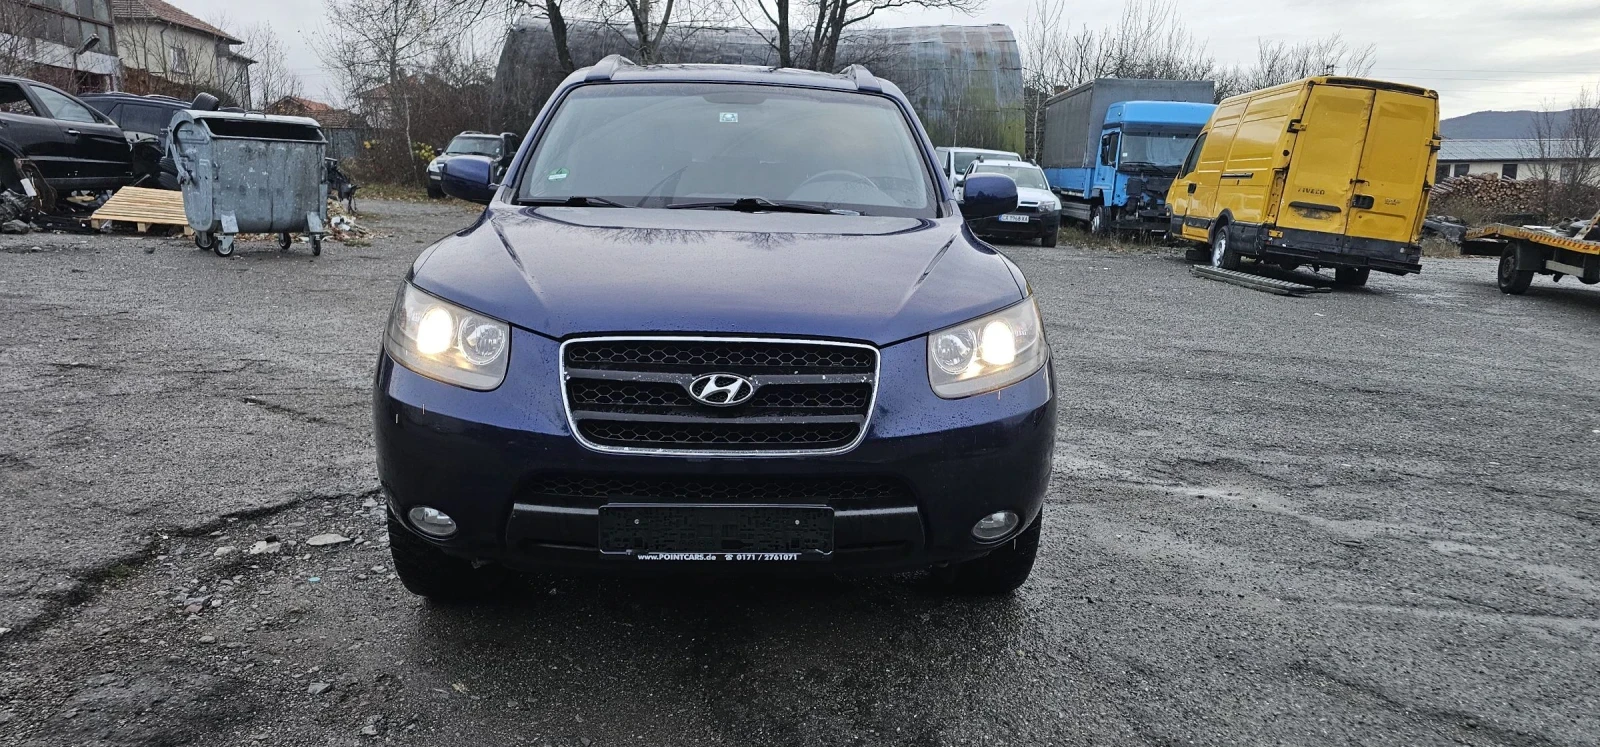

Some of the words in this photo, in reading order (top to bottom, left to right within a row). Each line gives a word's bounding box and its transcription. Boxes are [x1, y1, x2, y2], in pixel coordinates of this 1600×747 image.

[1302, 187, 1325, 196] IVECO
[637, 553, 717, 561] www.POINTCARS.de
[736, 553, 756, 561] 0171
[764, 553, 798, 561] 2761071
